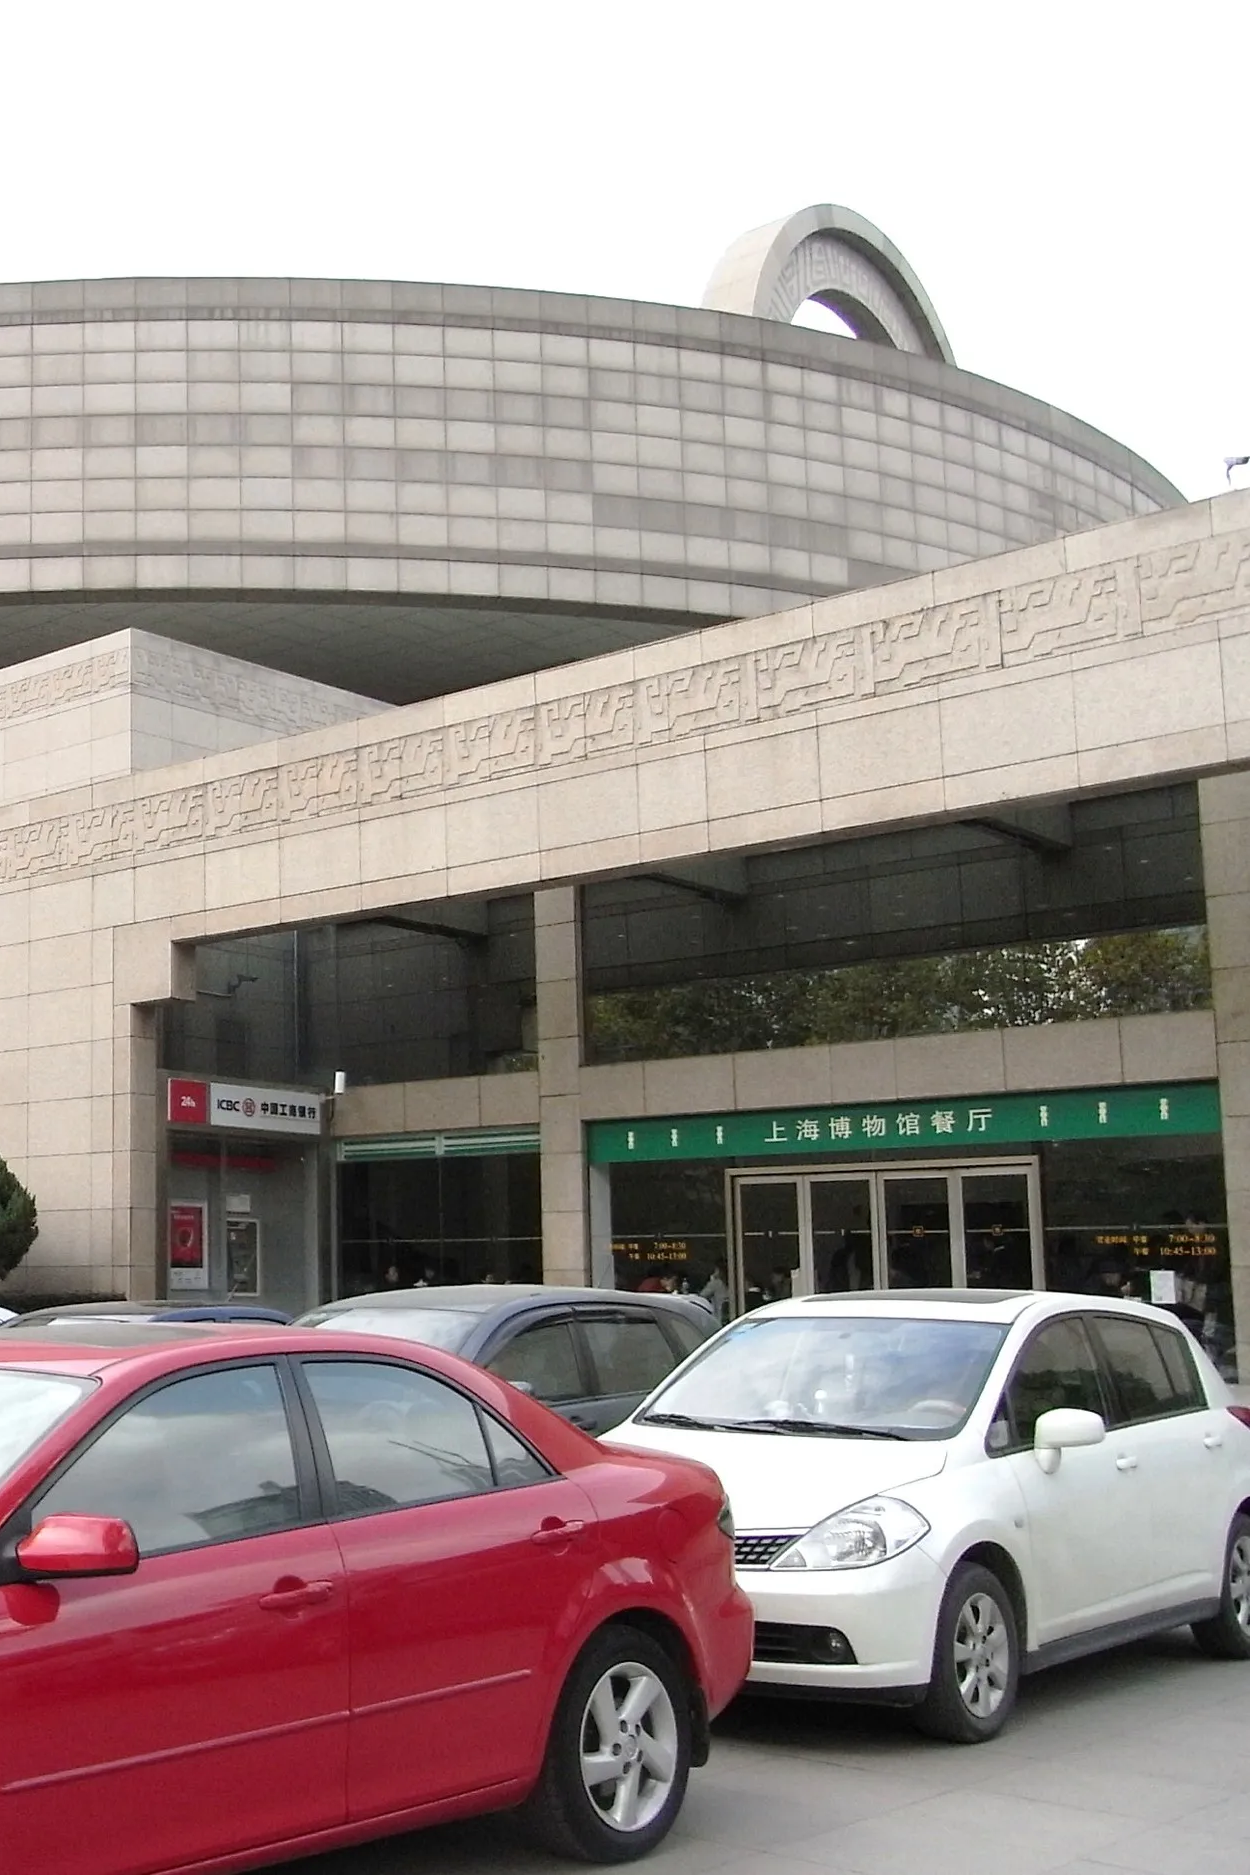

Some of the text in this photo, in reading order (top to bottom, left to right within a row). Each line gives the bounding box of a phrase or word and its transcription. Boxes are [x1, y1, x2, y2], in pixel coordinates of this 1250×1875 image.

[217, 1098, 240, 1112] ICBC
[260, 1101, 316, 1119] 中国工商银行
[764, 1108, 993, 1143] 上海博物馆餐厅
